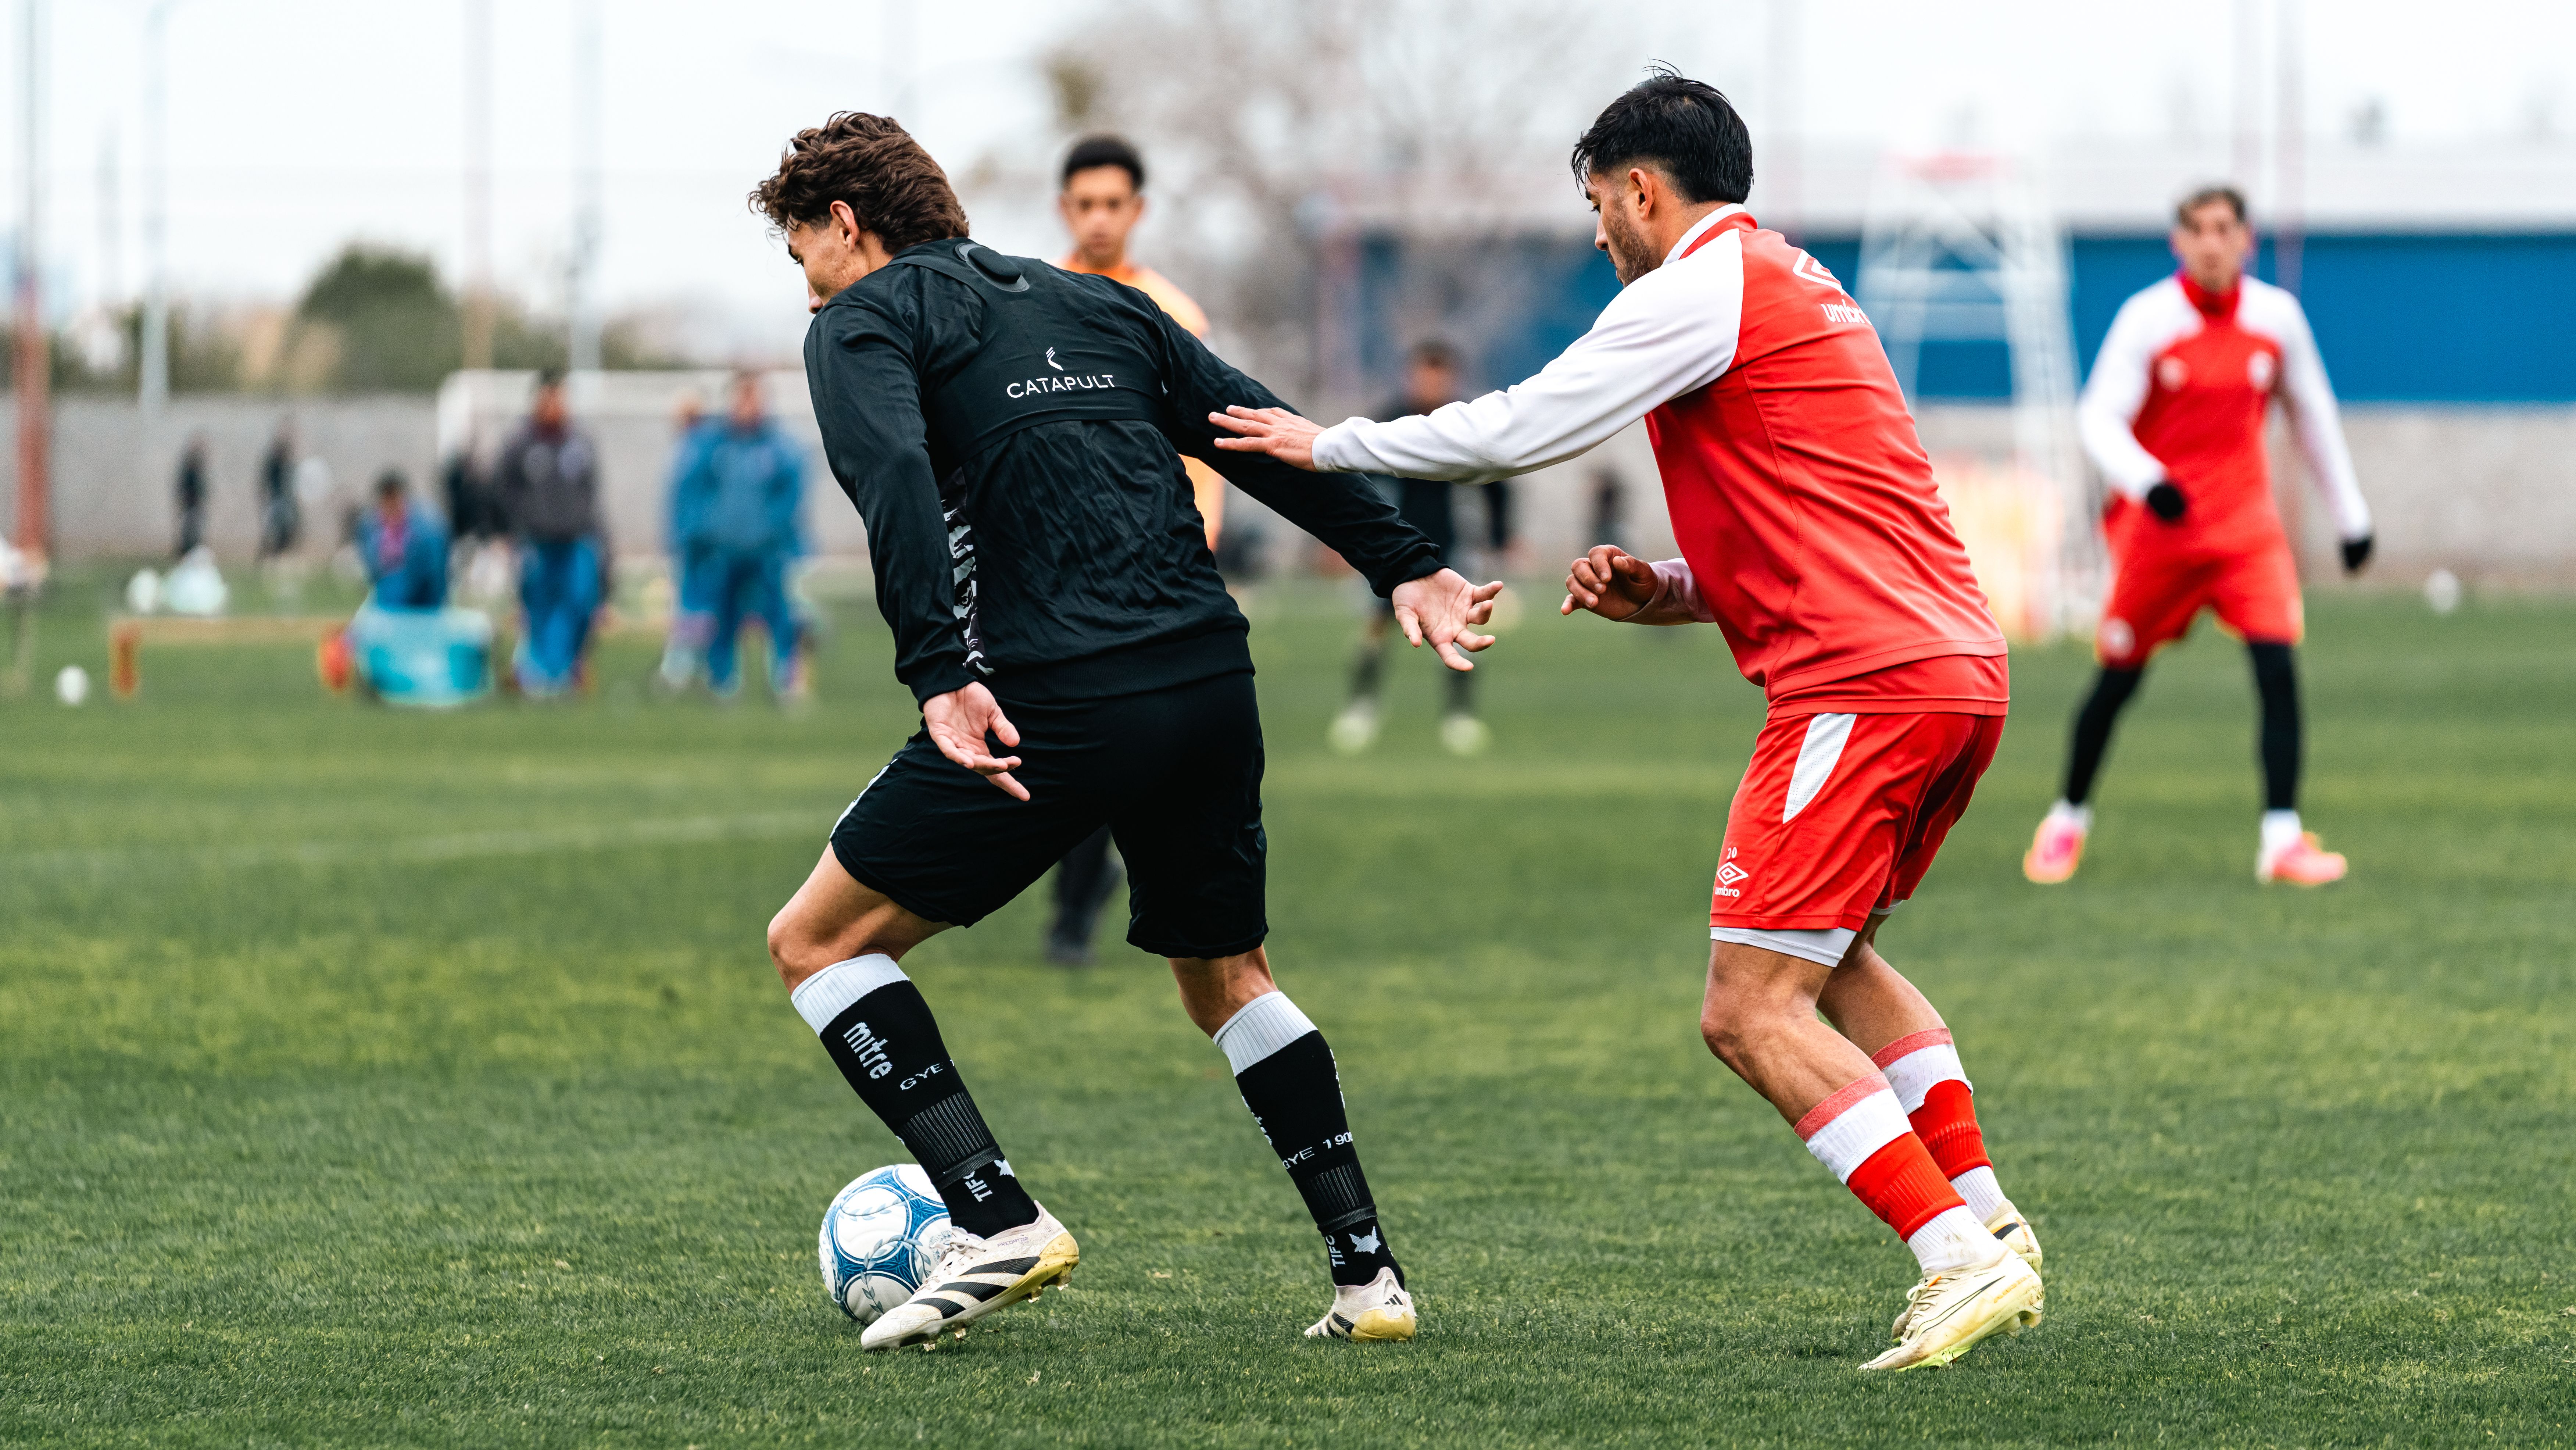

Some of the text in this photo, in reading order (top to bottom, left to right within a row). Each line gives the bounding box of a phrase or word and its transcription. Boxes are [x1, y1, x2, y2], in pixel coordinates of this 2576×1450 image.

[1007, 375, 1115, 398] CATAPULT
[1726, 847, 1737, 859] 20
[1715, 886, 1740, 897] umbro
[843, 1022, 893, 1079] mitre
[900, 1063, 944, 1090] GYE
[1282, 1147, 1315, 1169] GYE
[997, 1237, 1028, 1247] PREDATOR
